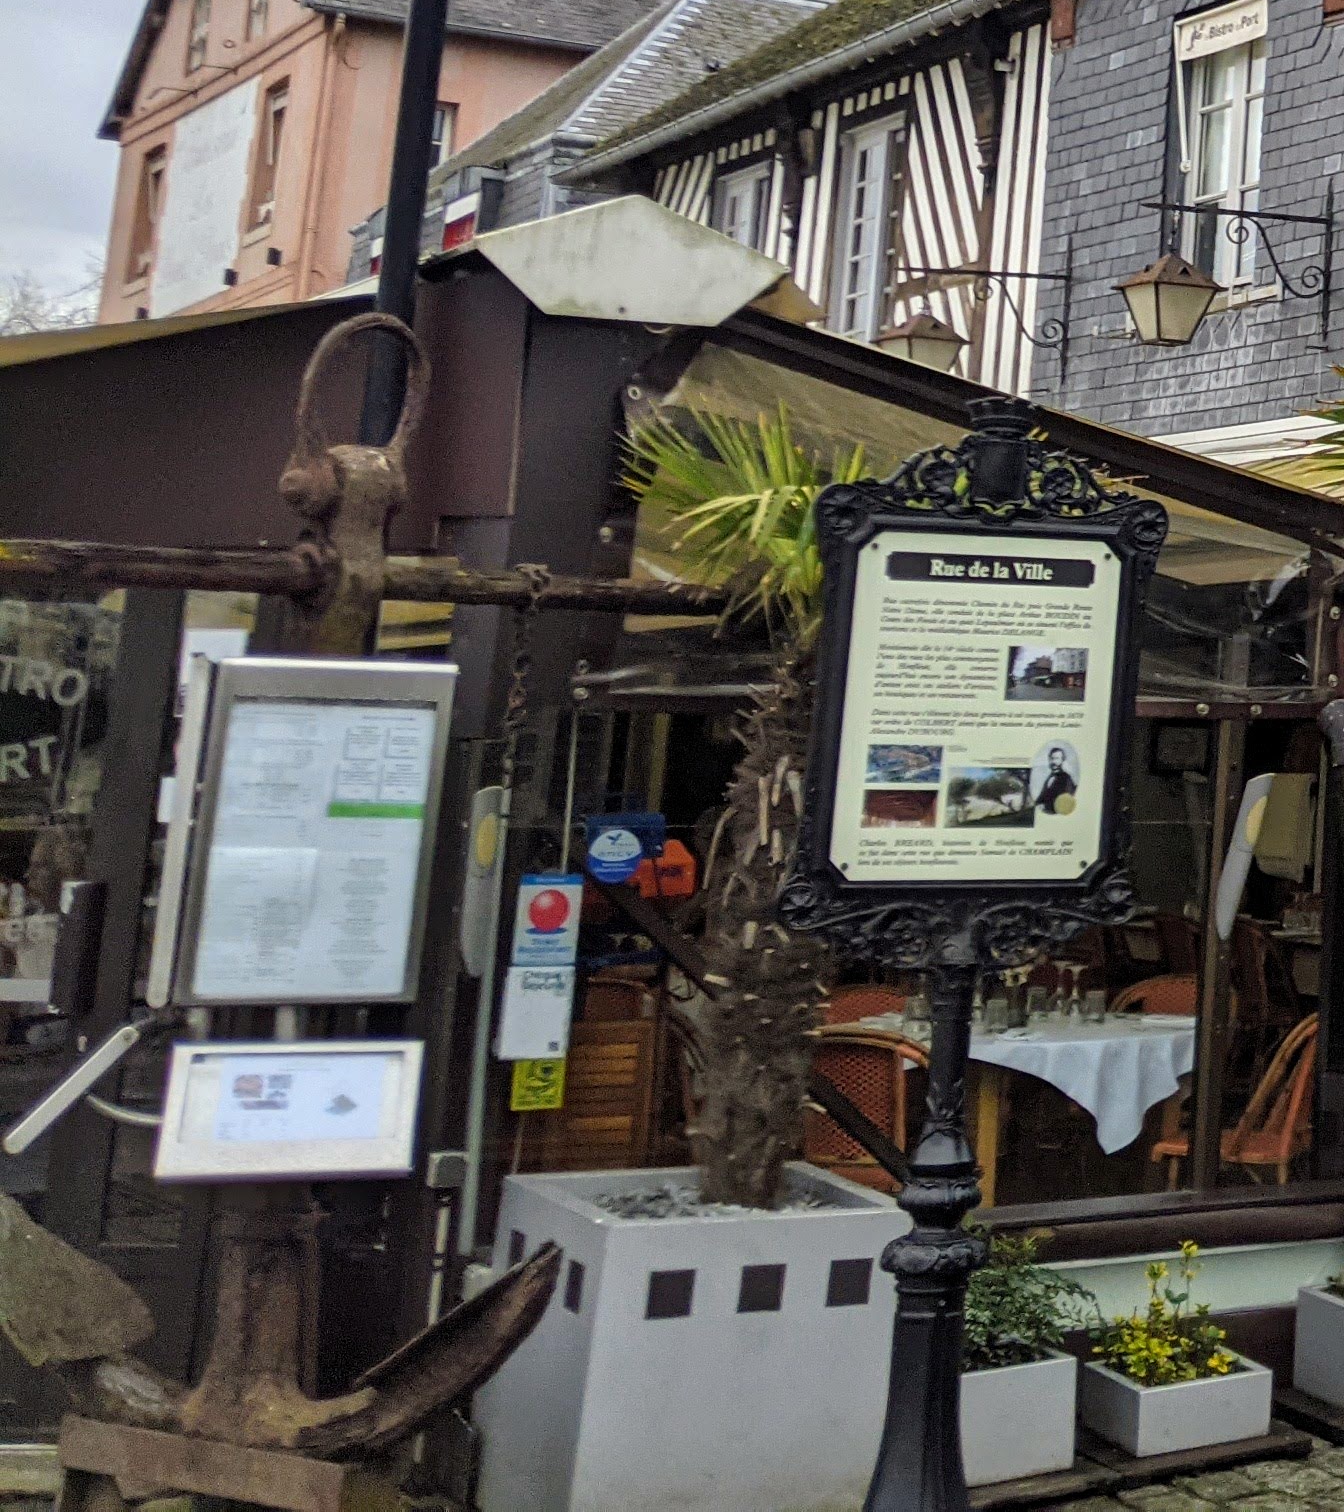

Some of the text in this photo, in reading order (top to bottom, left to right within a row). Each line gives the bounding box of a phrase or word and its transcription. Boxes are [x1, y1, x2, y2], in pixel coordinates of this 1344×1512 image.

[929, 558, 1053, 581] Rue de la Ville
[0, 654, 89, 707] TRO
[0, 735, 57, 782] RT
